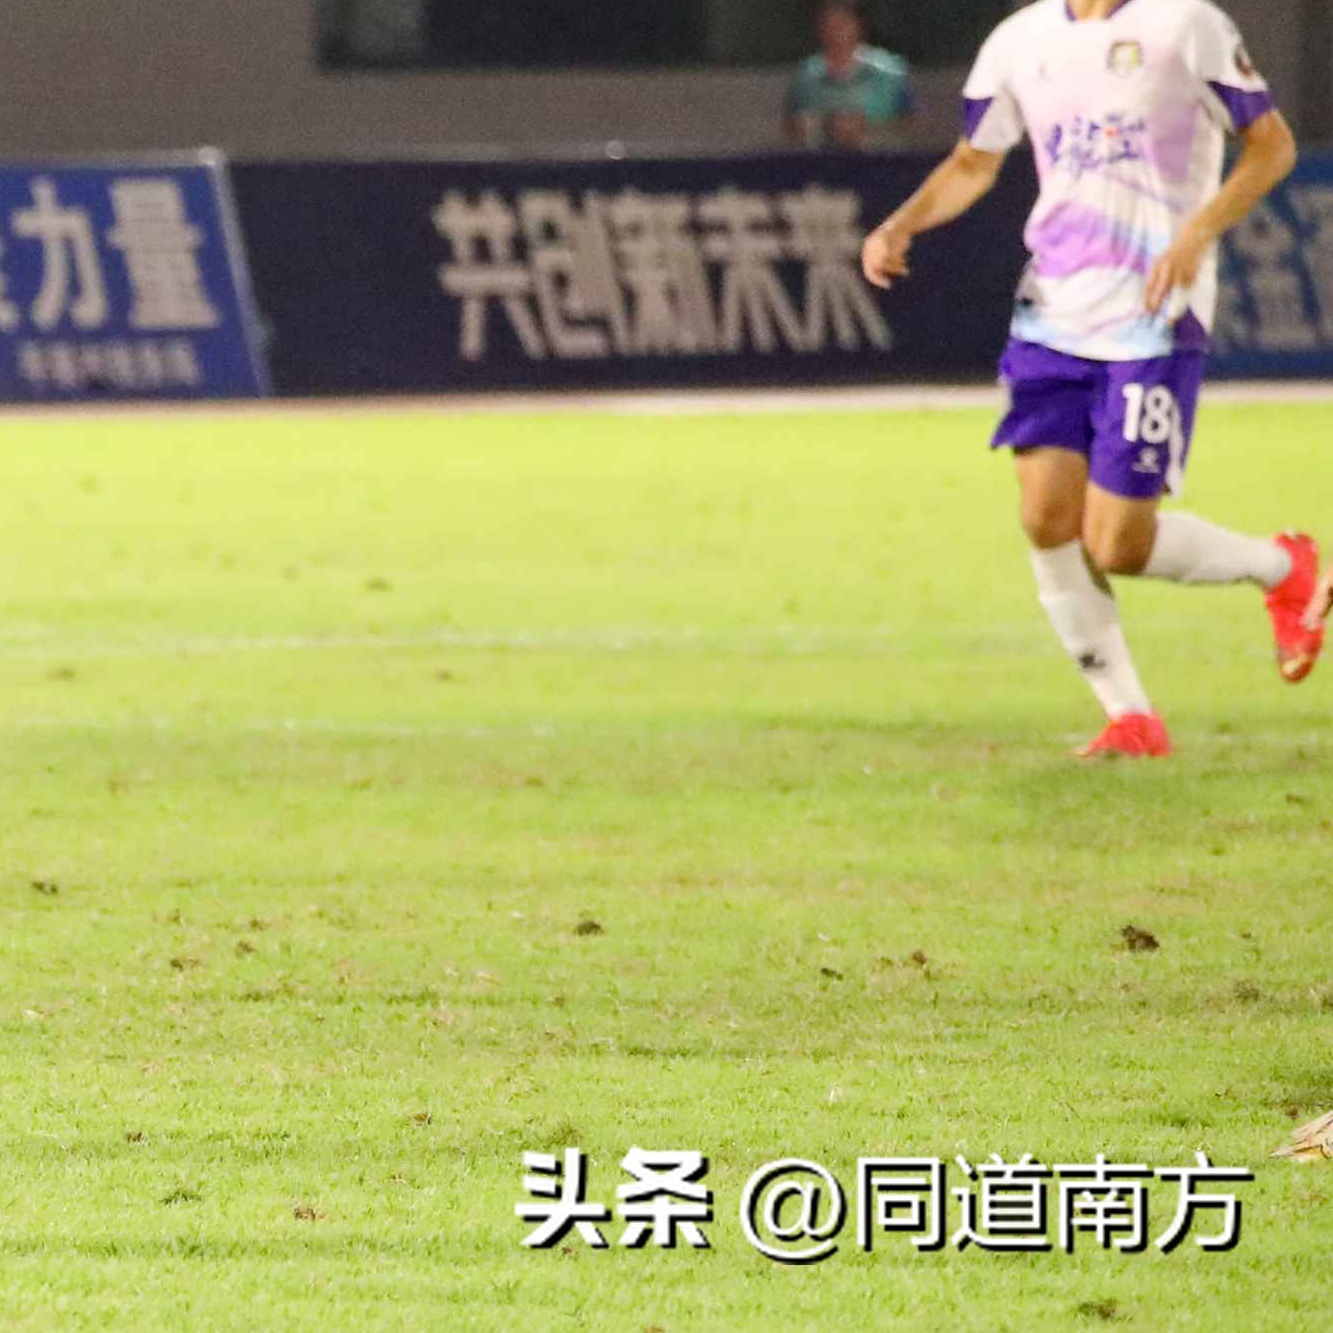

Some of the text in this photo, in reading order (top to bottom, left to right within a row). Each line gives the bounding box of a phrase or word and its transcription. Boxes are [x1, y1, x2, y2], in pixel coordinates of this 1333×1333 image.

[432, 186, 893, 361] 共创新未来
[1122, 382, 1172, 444] 18
